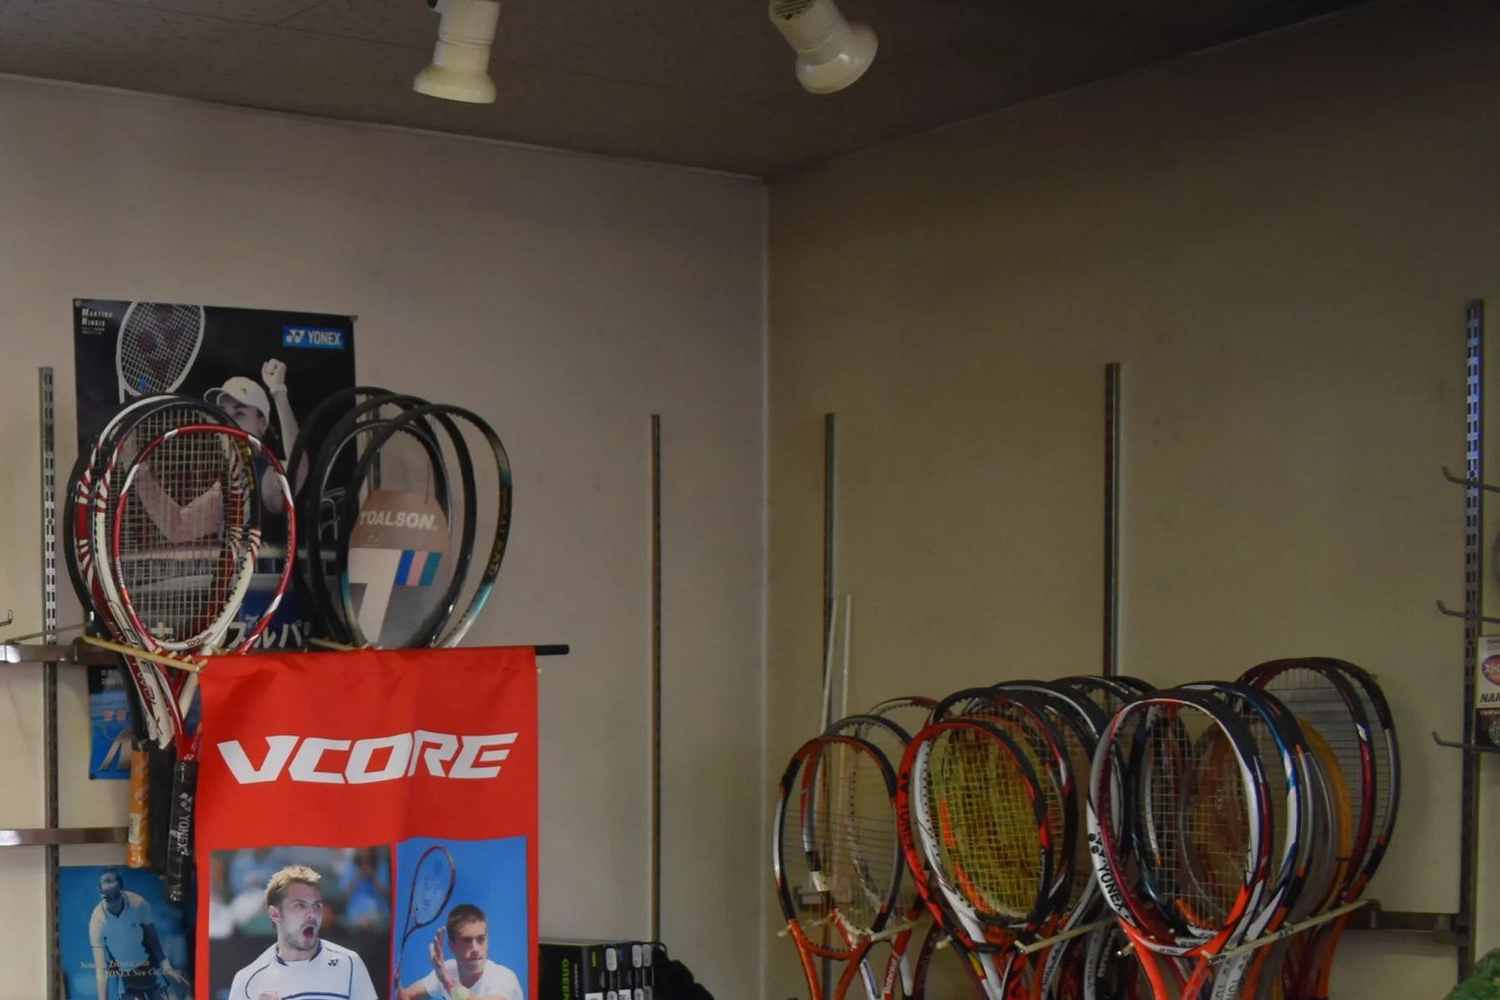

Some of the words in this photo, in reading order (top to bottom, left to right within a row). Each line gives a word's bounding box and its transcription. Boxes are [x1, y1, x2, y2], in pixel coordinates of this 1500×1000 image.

[307, 330, 341, 346] YONEX
[216, 729, 519, 784] VCORE
[178, 814, 190, 856] YONEX
[1098, 865, 1124, 911] YONEX
